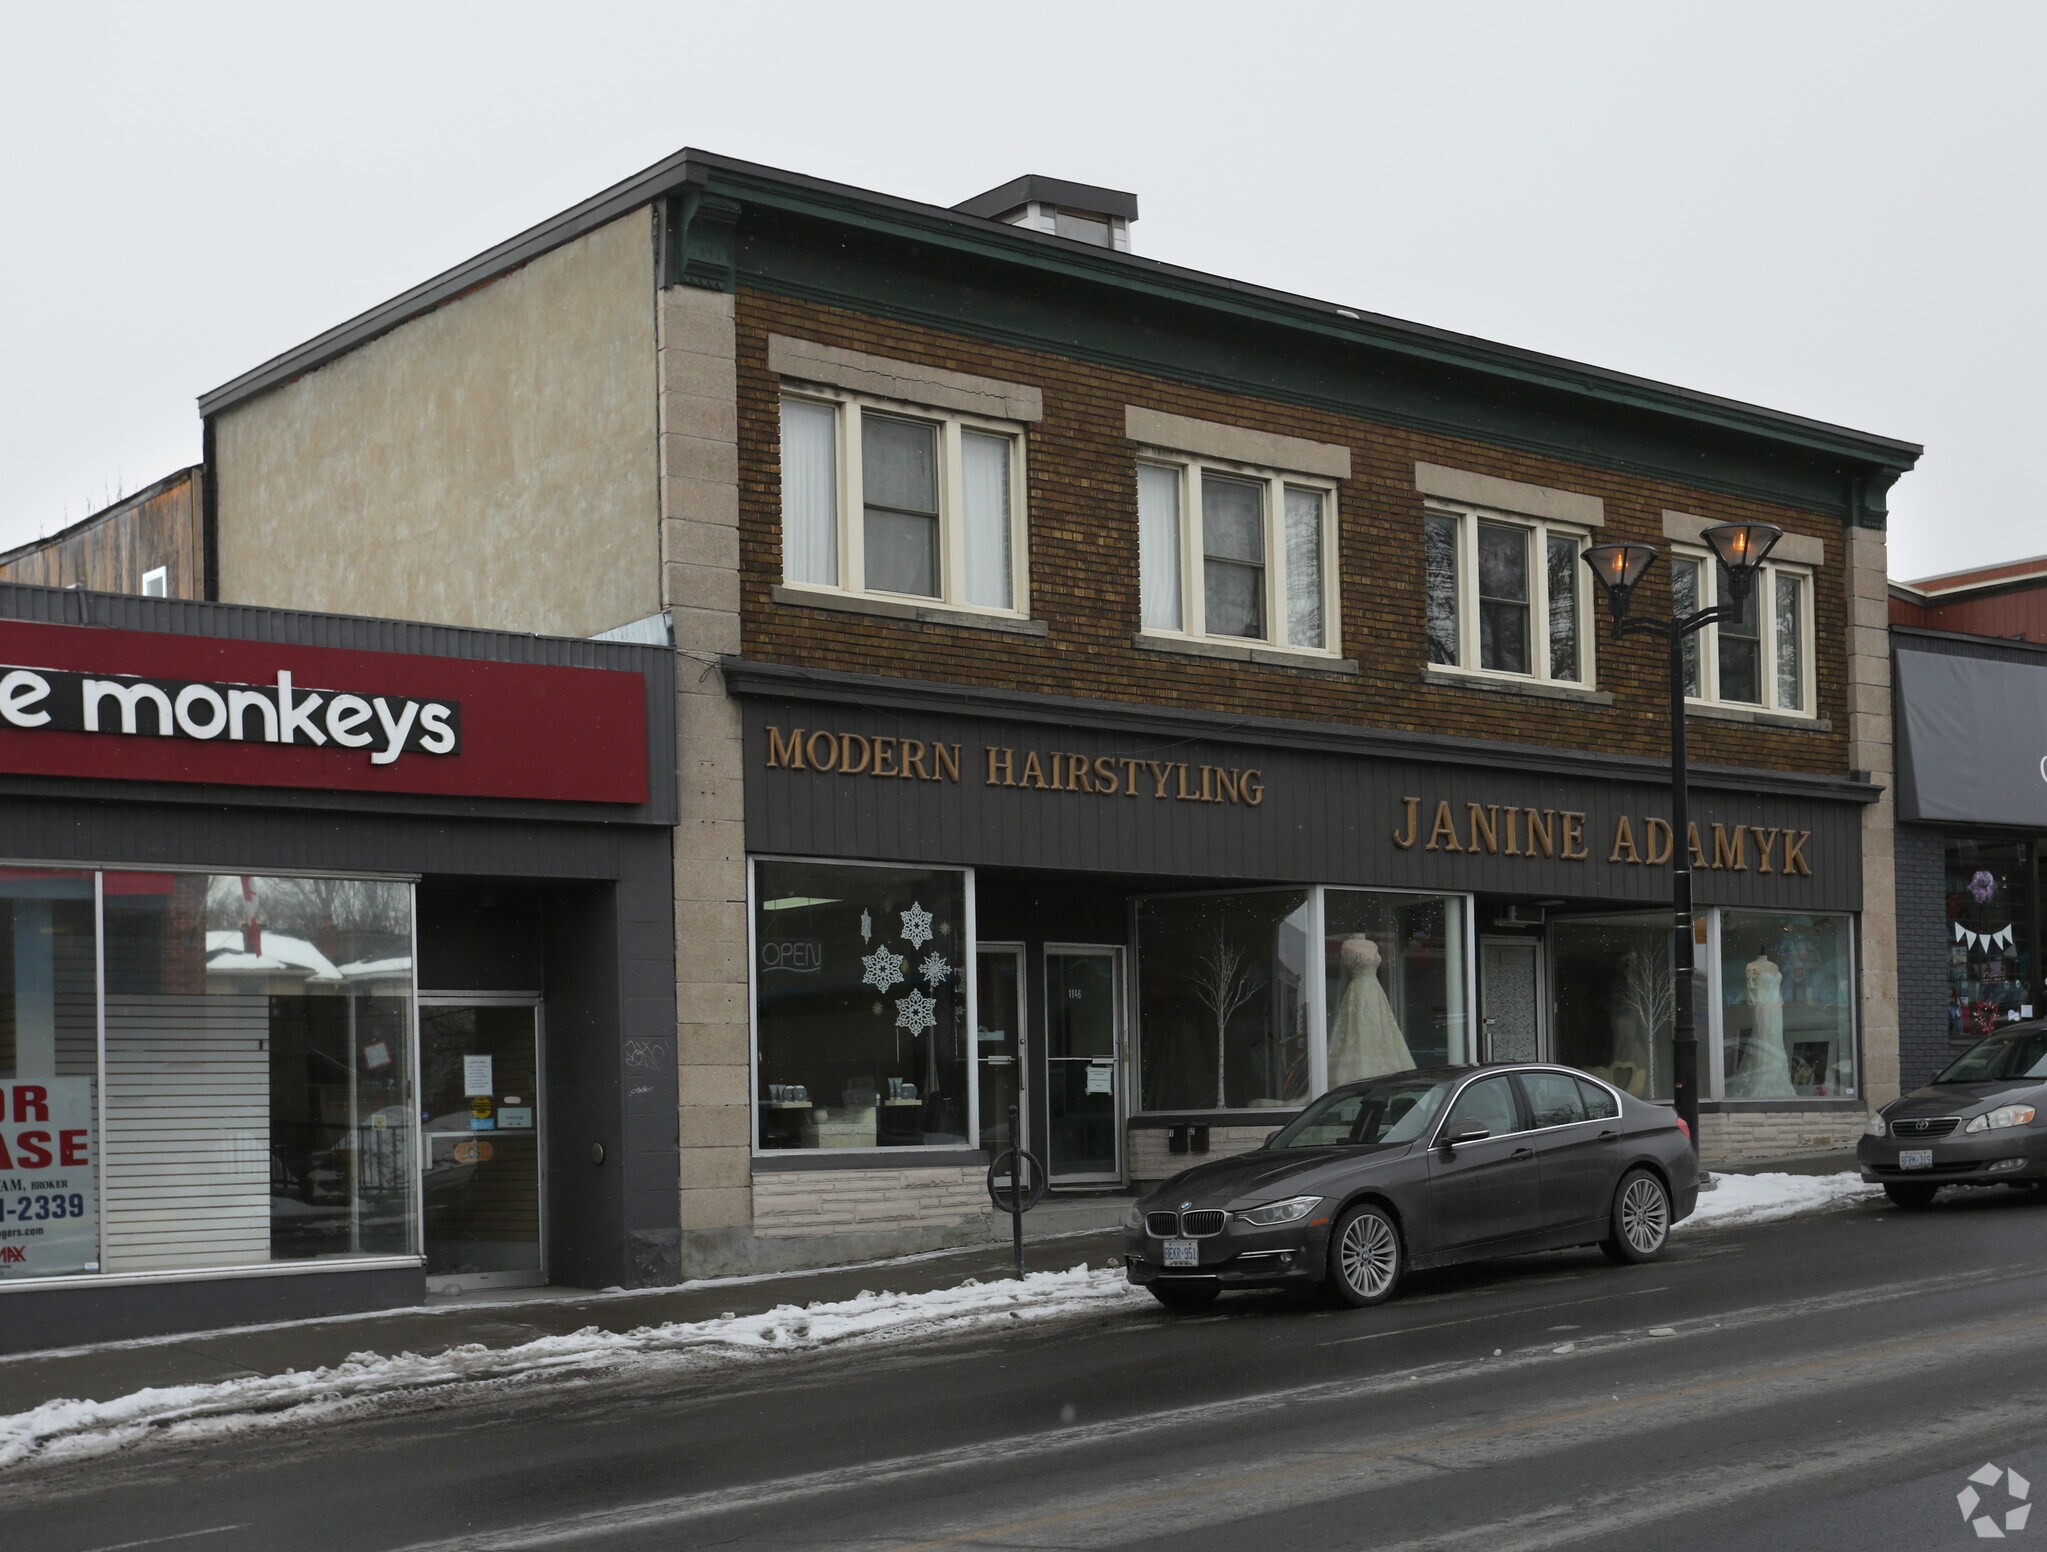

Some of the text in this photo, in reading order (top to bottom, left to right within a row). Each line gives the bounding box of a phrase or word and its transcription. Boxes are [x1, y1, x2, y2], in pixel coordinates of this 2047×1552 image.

[82, 669, 456, 765] monkeys
[765, 726, 1265, 806] MODERN HAIRSTYLING
[1393, 796, 1589, 861] JANINE
[762, 943, 822, 966] OPEN
[31, 1180, 68, 1190] BROKER
[0, 1227, 44, 1239] gers.com
